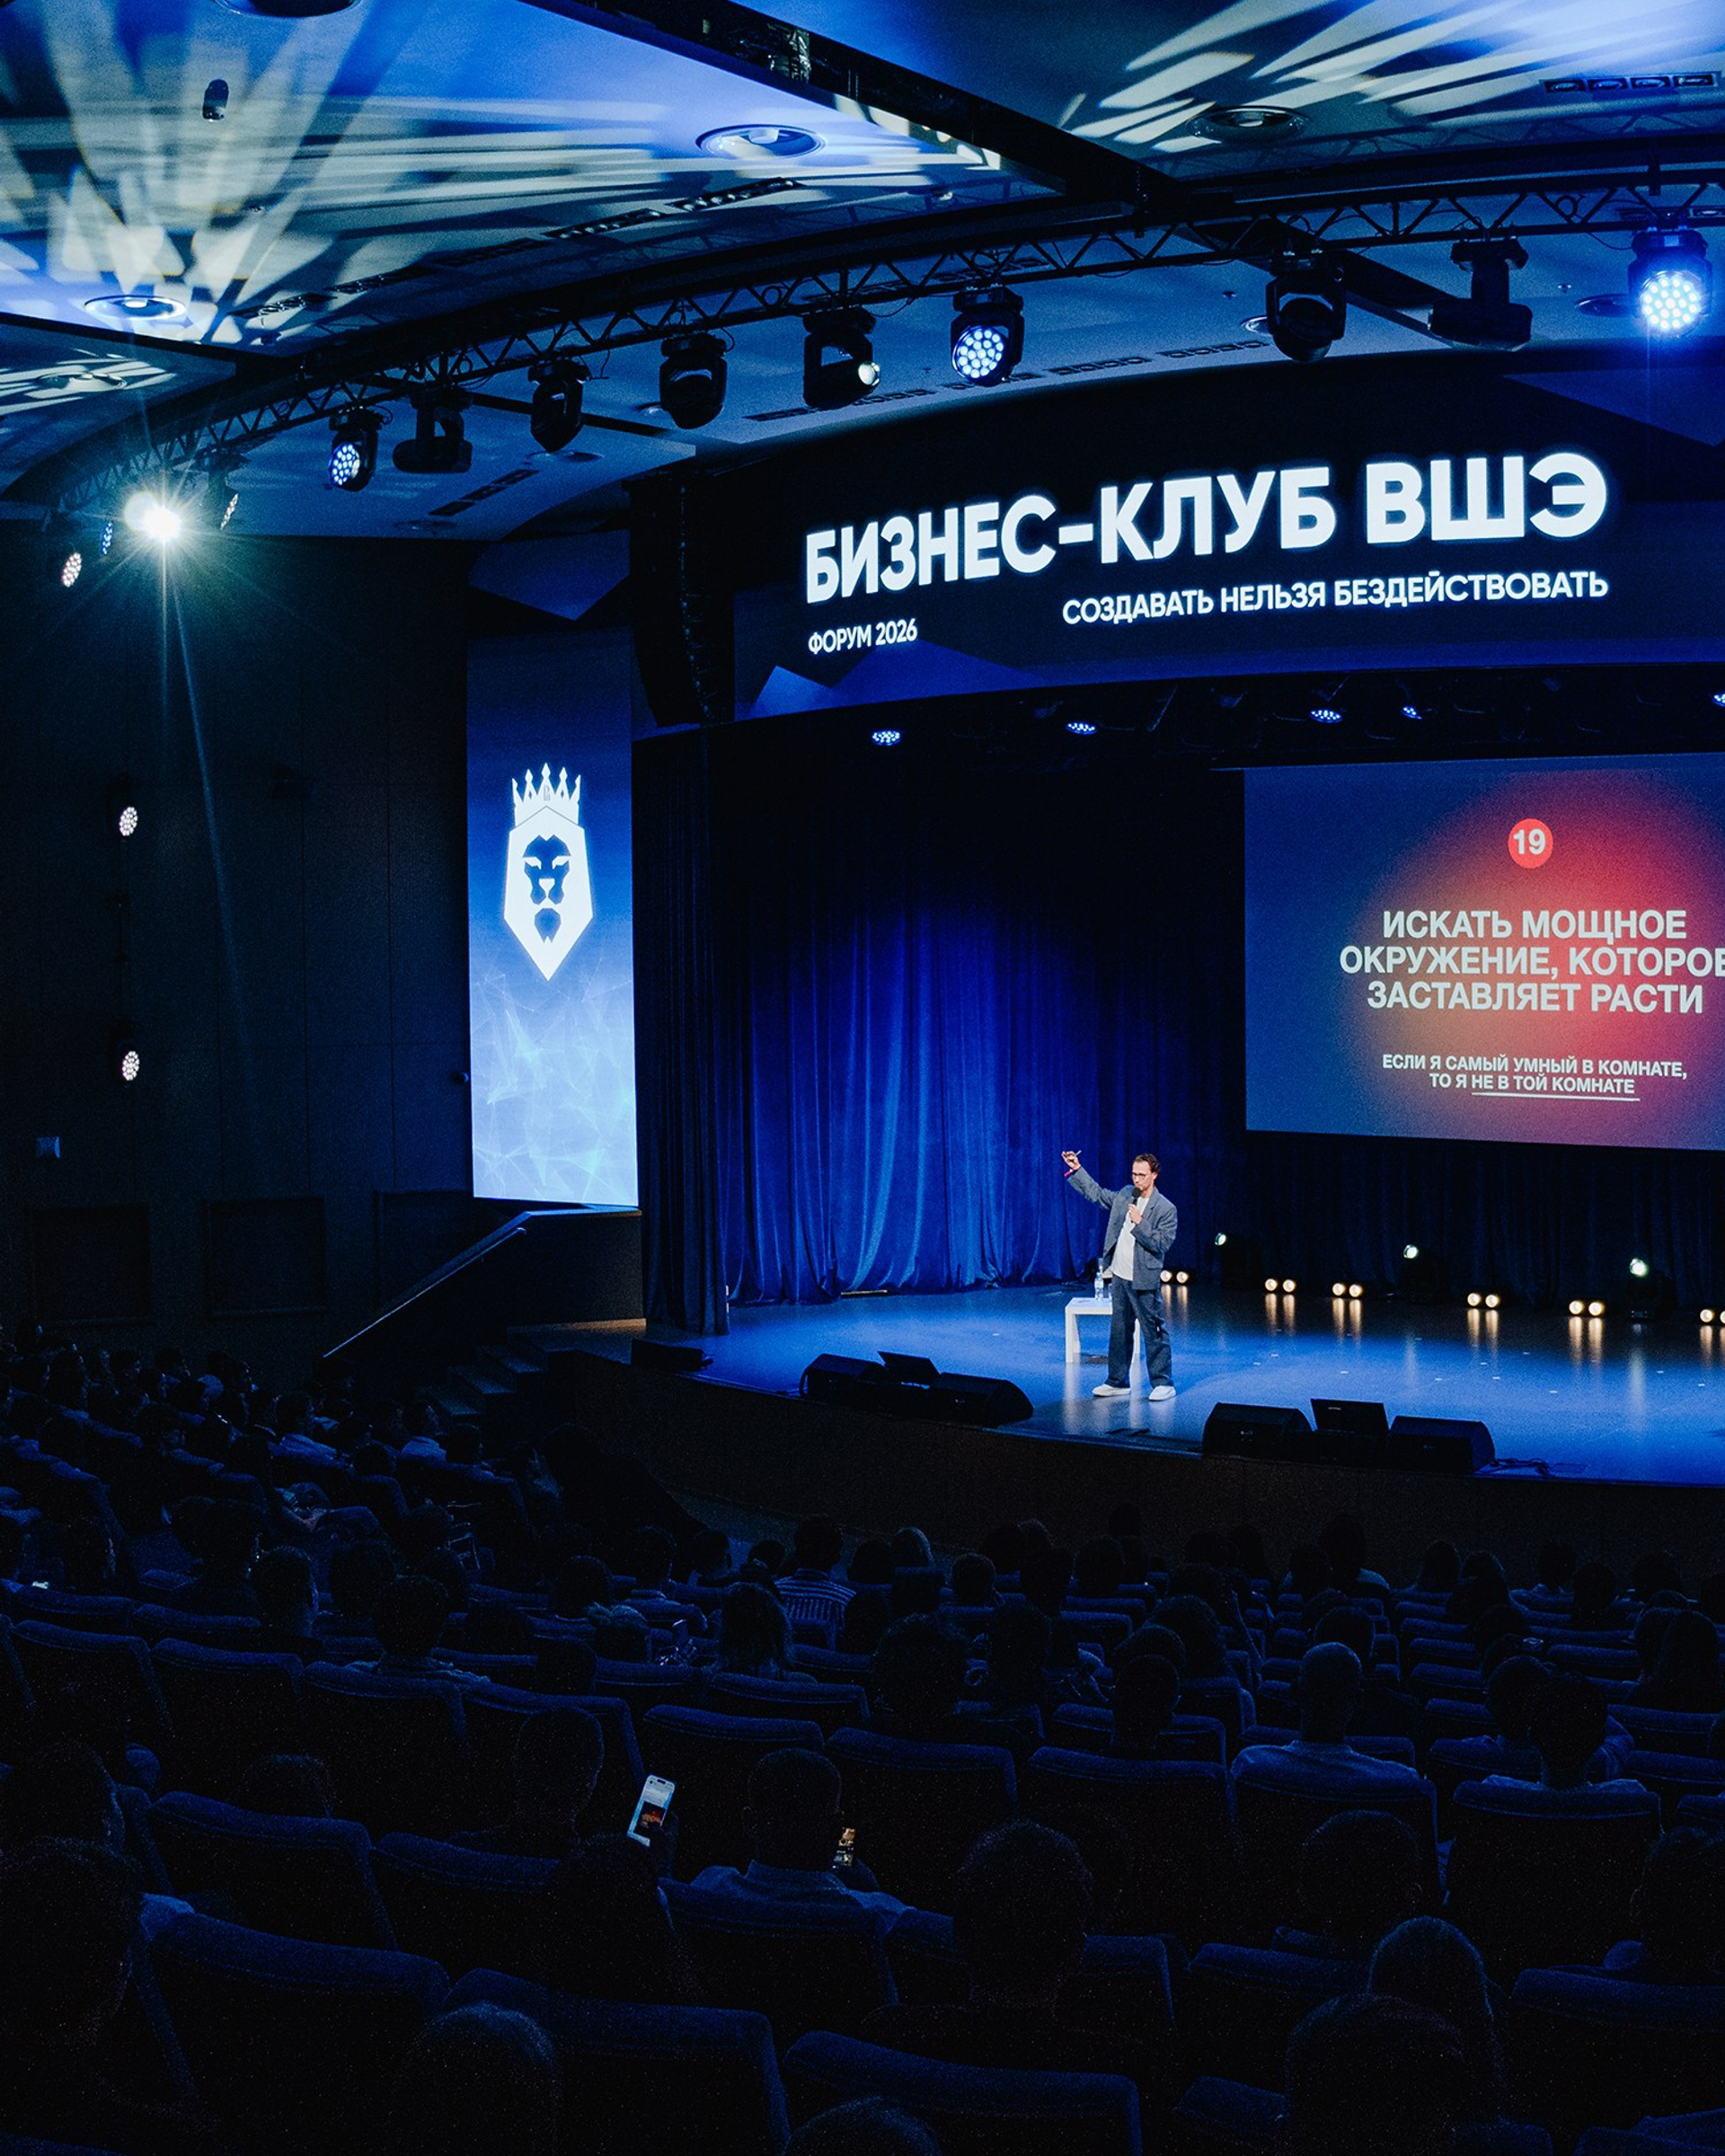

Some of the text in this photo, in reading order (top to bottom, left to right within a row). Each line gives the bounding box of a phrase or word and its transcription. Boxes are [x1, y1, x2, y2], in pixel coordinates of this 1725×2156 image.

[806, 453, 1607, 604] БИЗНЕС-КЛУБ ВШЭ
[1062, 570, 1609, 624] СОЗДАВАТЬ НЕЛЬЗЯ БЕЗДЕЙСТВОВАТЬ
[808, 618, 918, 655] ФОРУМ 2026
[1513, 828, 1546, 854] 19
[1383, 909, 1687, 945] ИСКАТЬ МОЩНОЕ
[1340, 945, 1559, 980] ОКРУЖЕНИЕ,
[1367, 980, 1703, 1014] ЗАСТАВЛЯЕТ РАСТИ
[1382, 1053, 1687, 1080] ЕСЛИ Я САМЫЙ УМНЫЙ В КОМНАТЕ,
[1429, 1072, 1635, 1094] ТО Я НЕ В ТОЙ КОМНАТЕ
